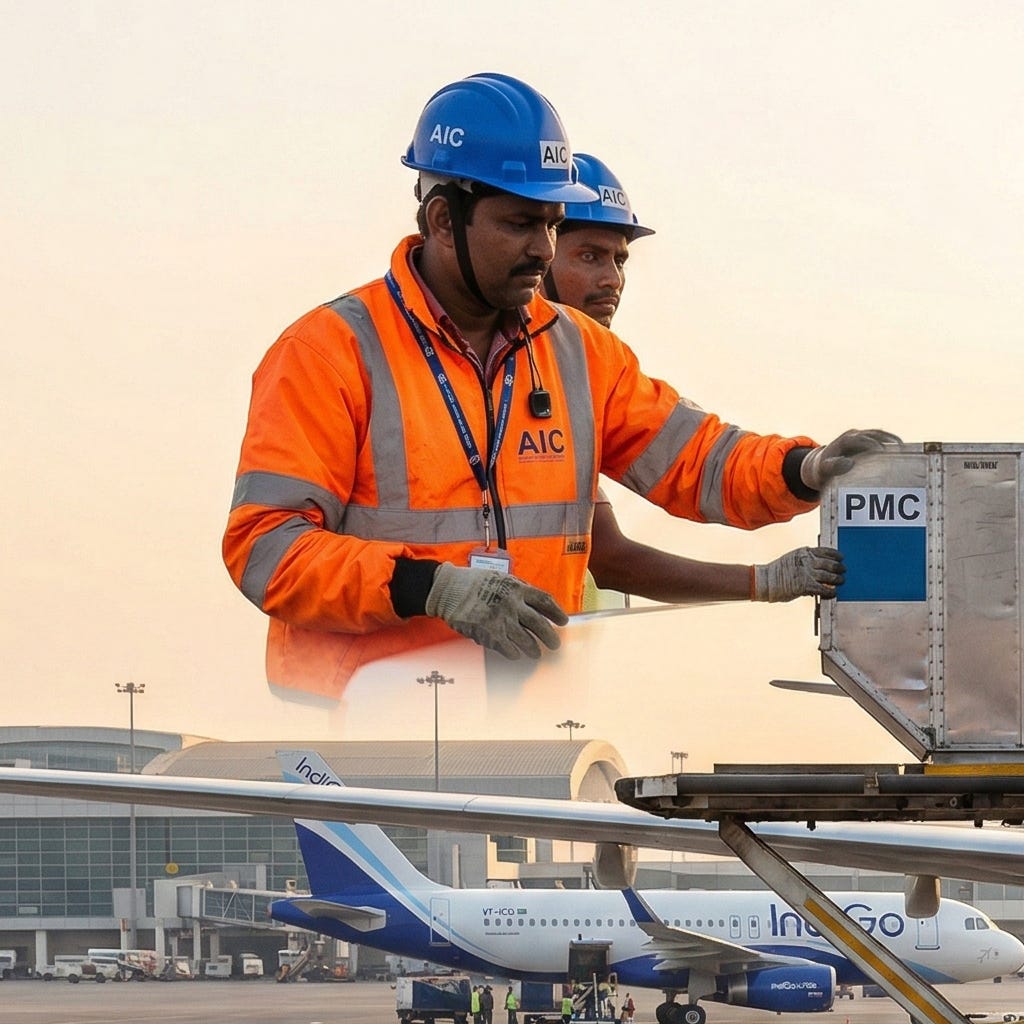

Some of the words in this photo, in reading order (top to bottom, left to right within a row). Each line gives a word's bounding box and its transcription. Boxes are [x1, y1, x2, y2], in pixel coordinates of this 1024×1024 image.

[430, 124, 465, 147] AIC
[543, 146, 568, 163] AIC
[602, 189, 626, 205] AIC
[518, 429, 565, 455] AIC
[845, 493, 921, 521] PMC
